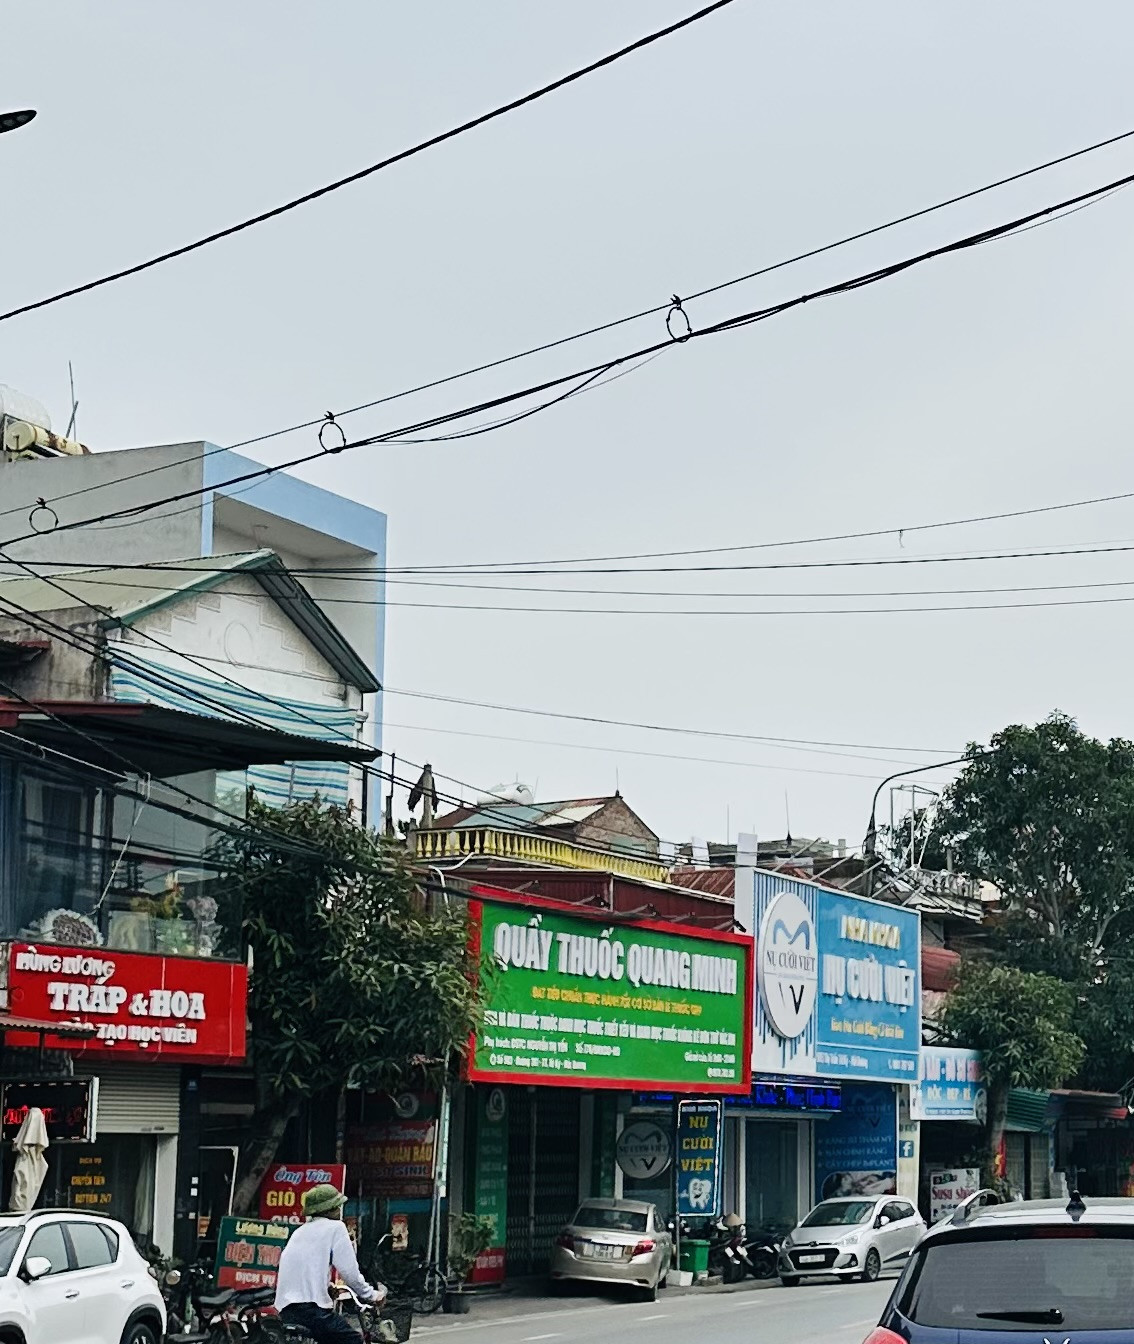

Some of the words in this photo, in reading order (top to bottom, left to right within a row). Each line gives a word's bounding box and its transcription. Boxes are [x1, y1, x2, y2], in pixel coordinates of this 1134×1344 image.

[556, 927, 625, 980] THUỐC
[627, 943, 690, 988] QUANG
[691, 954, 738, 995] MINH
[128, 993, 149, 1016] &
[149, 989, 206, 1020] HOA
[97, 1024, 127, 1046] TẠO
[128, 1025, 160, 1048] HỌC
[161, 1022, 197, 1044] VIÊN
[681, 1157, 713, 1174] VIỆT
